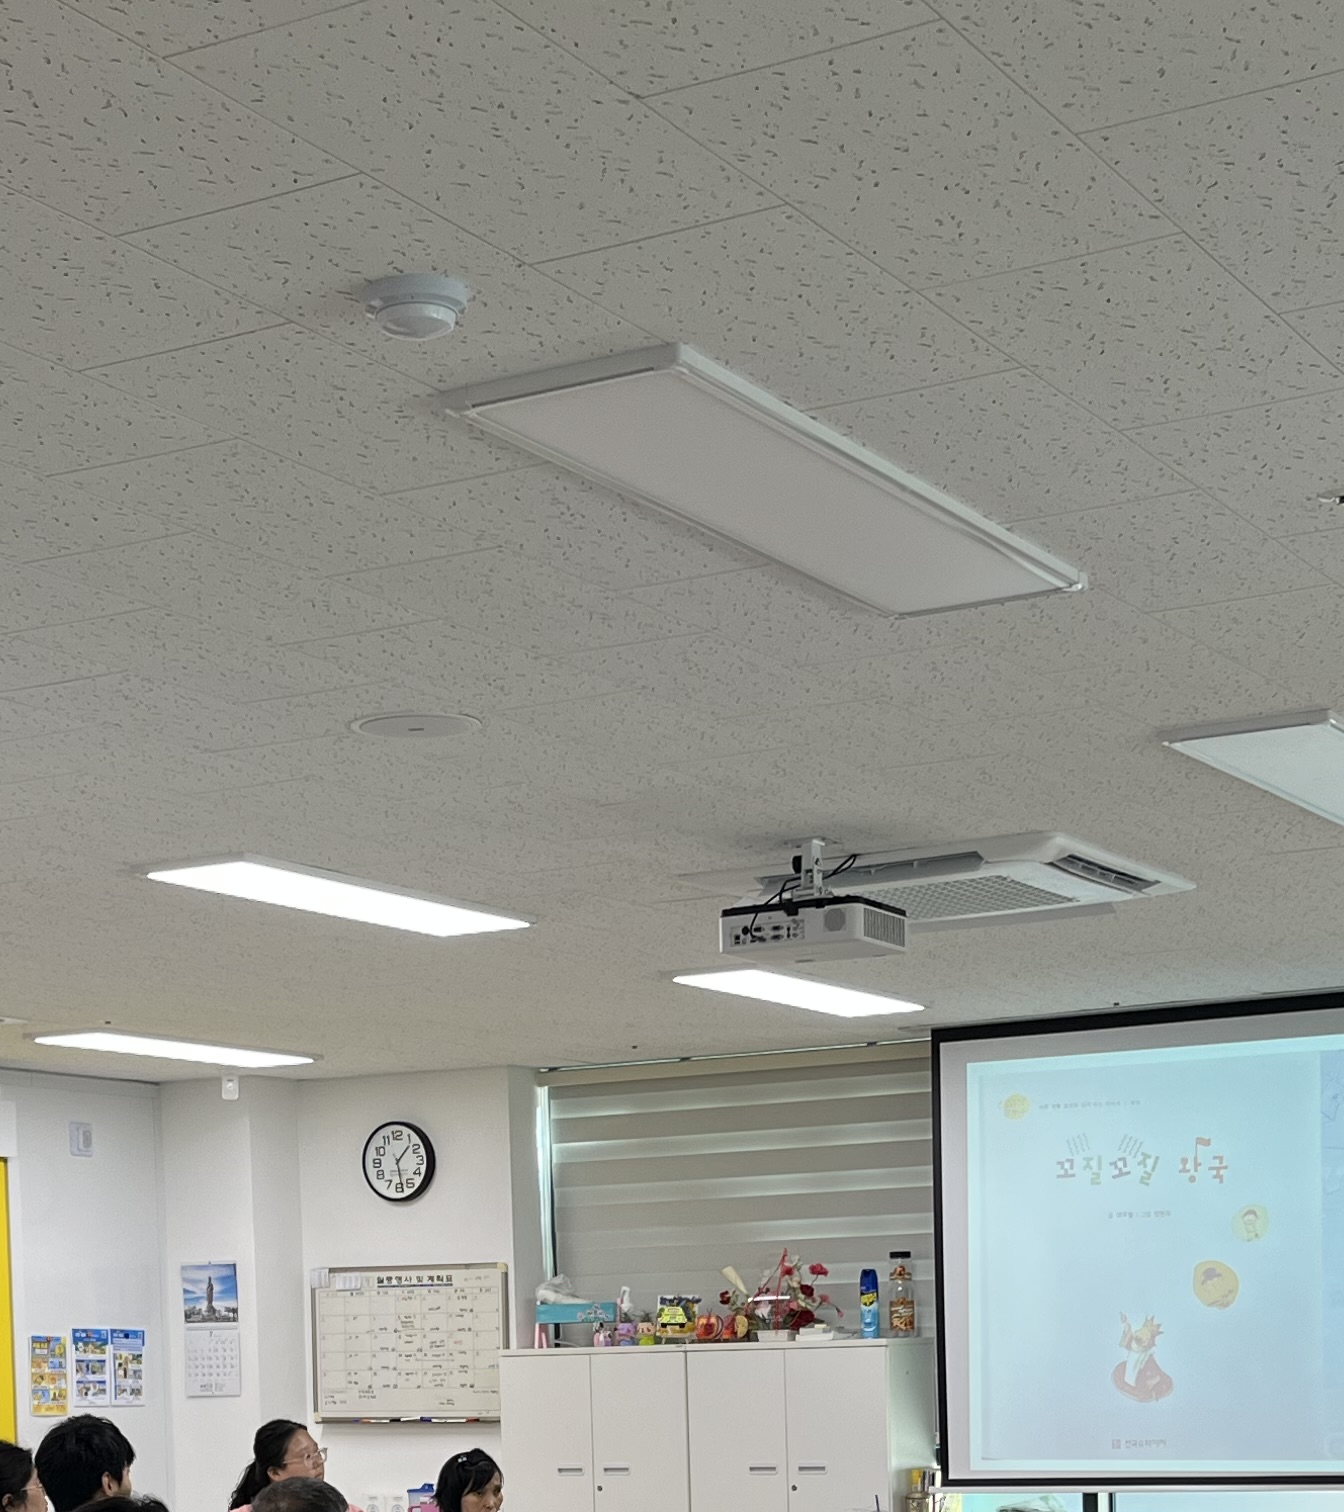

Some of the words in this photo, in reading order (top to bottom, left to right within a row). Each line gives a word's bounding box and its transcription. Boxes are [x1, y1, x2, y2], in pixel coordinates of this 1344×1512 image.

[382, 1135, 391, 1146] 11
[391, 1130, 404, 1141] 12
[407, 1133, 412, 1145] 1
[375, 1146, 386, 1157] 10
[412, 1143, 421, 1155] 2
[372, 1158, 382, 1169] 9
[416, 1154, 425, 1166] 3
[1055, 1150, 1160, 1187] 꼬질꼬질
[1177, 1137, 1229, 1185] 왕국
[376, 1169, 385, 1180] 8
[412, 1166, 422, 1178] 4
[384, 1179, 393, 1191] 7
